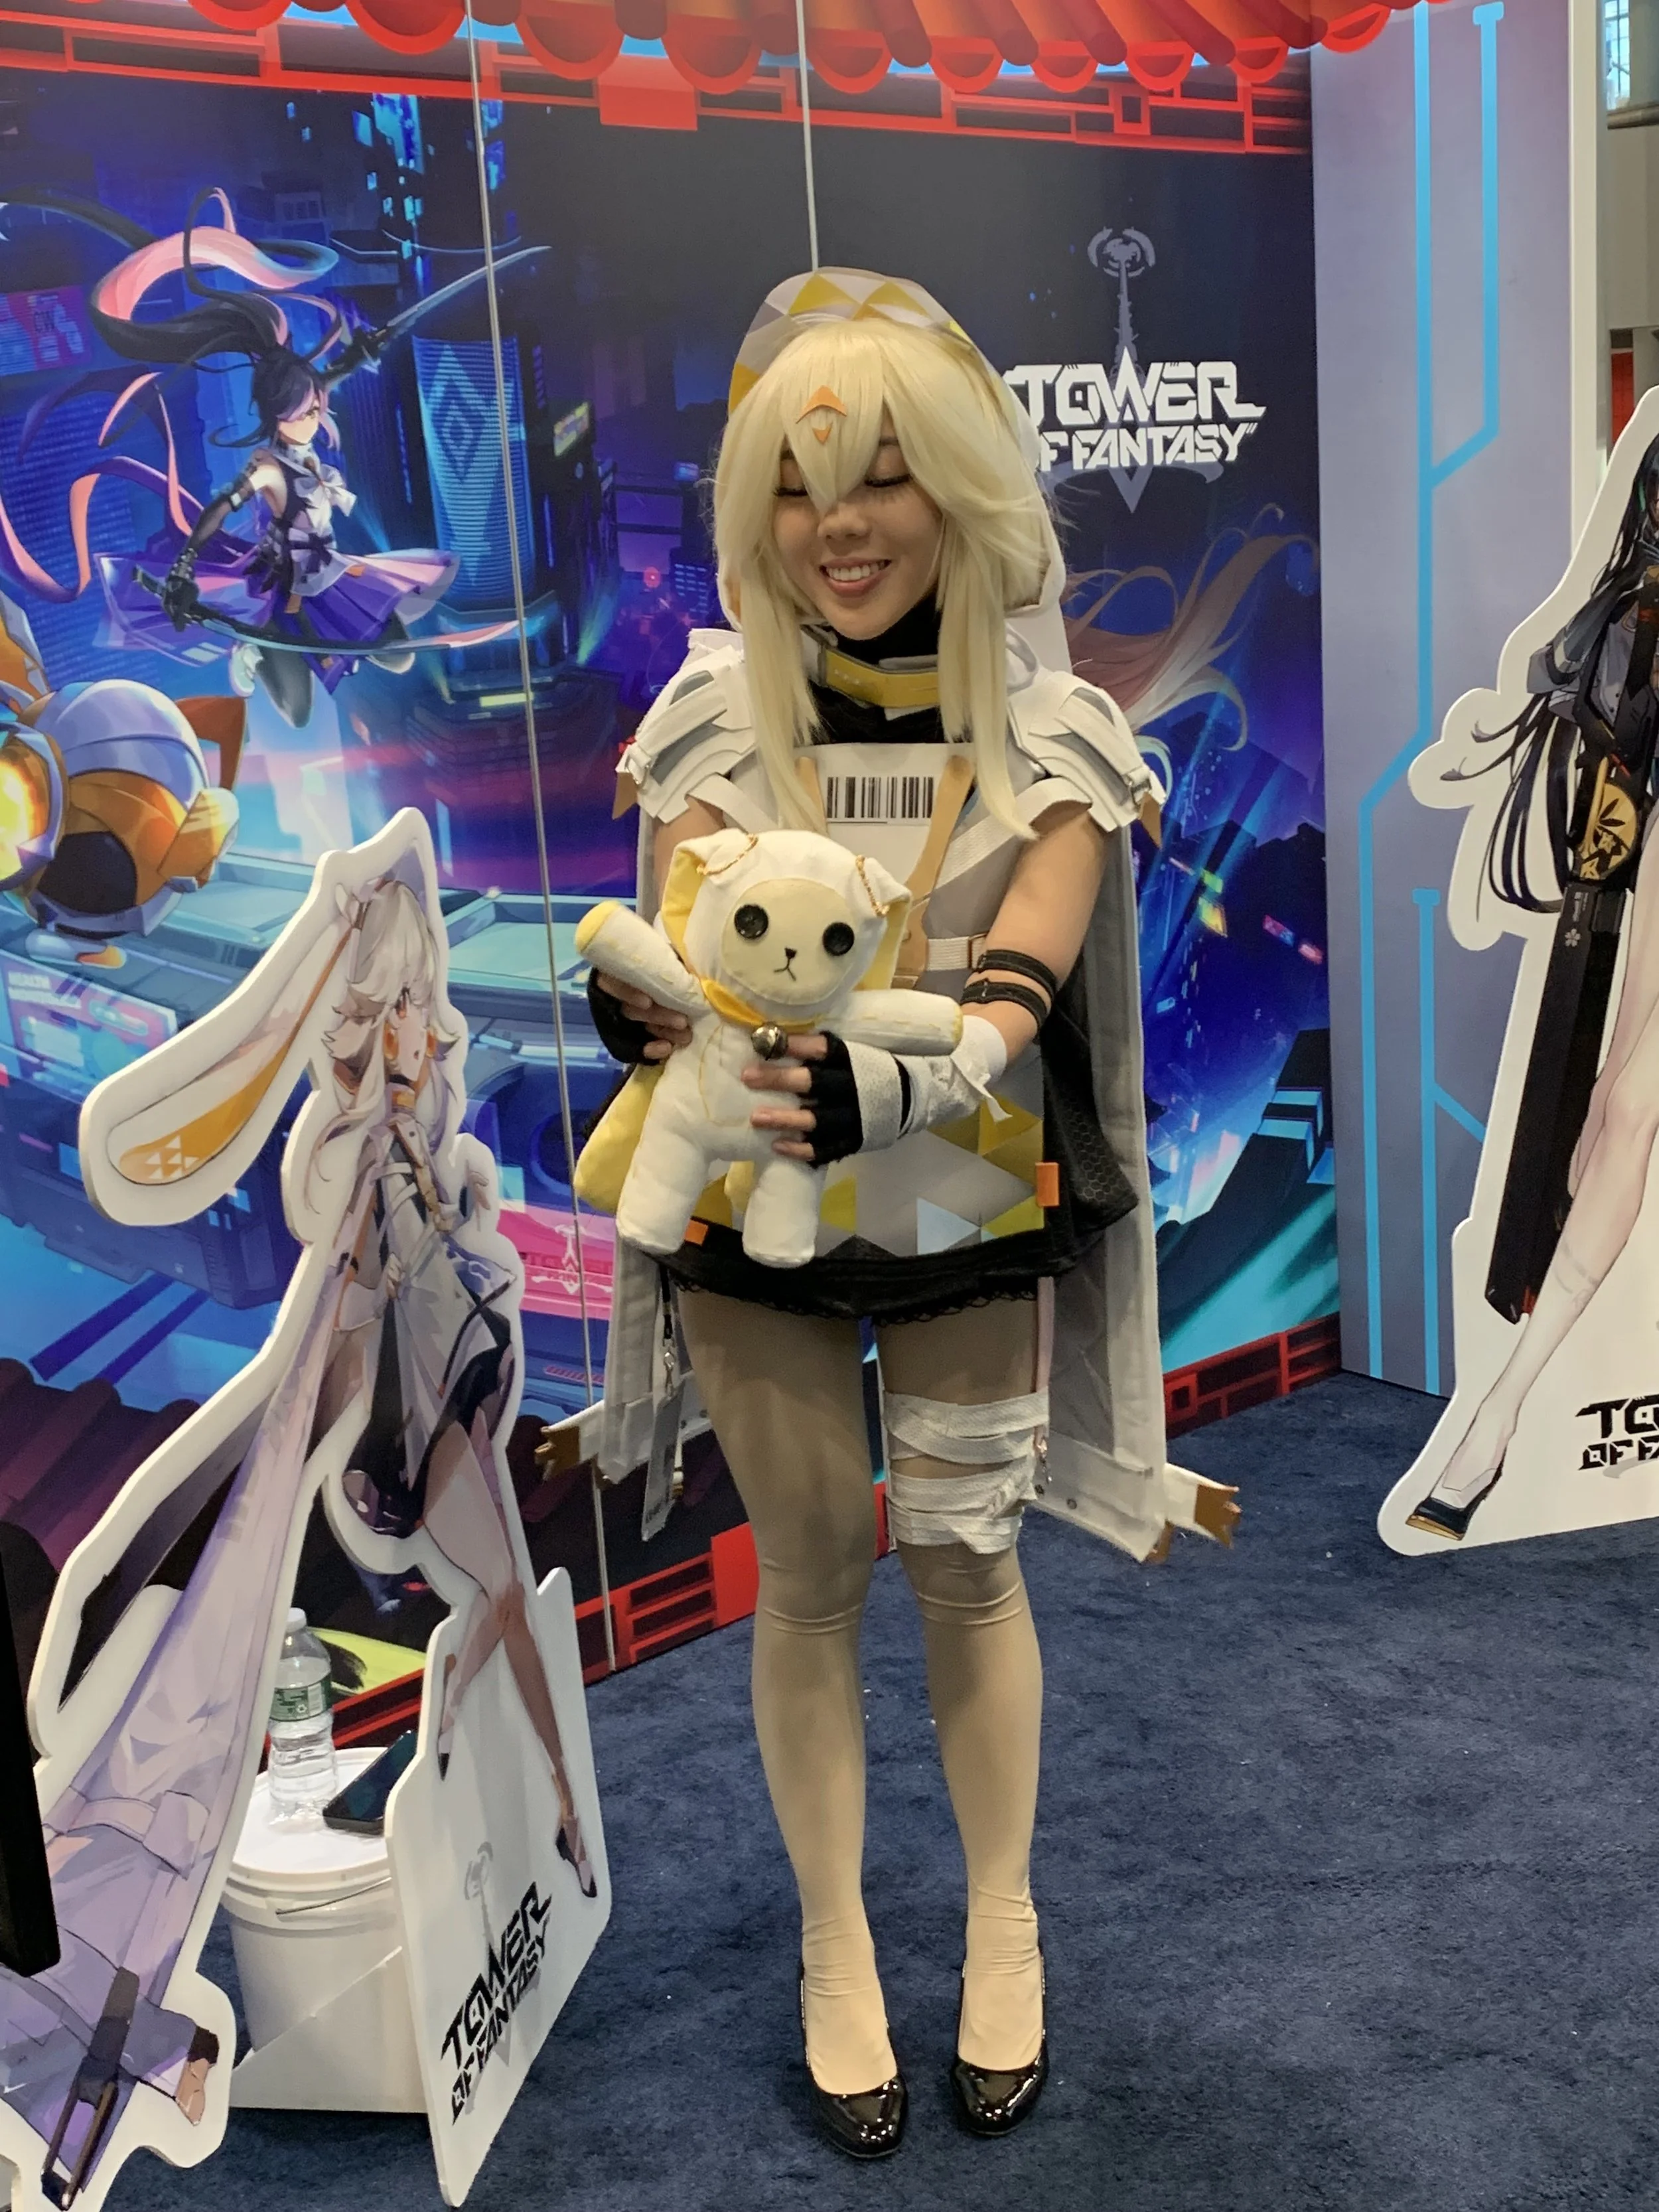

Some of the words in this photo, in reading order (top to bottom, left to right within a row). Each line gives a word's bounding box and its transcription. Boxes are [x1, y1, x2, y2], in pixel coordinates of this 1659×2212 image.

[1003, 347, 1266, 425] TOWER
[1038, 431, 1068, 471] F
[1072, 423, 1258, 470] FANTASY
[1578, 1443, 1634, 1471] OF
[441, 1881, 552, 2069] TOWER
[452, 2052, 475, 2126] OF
[476, 1912, 551, 2073] FANTASY
